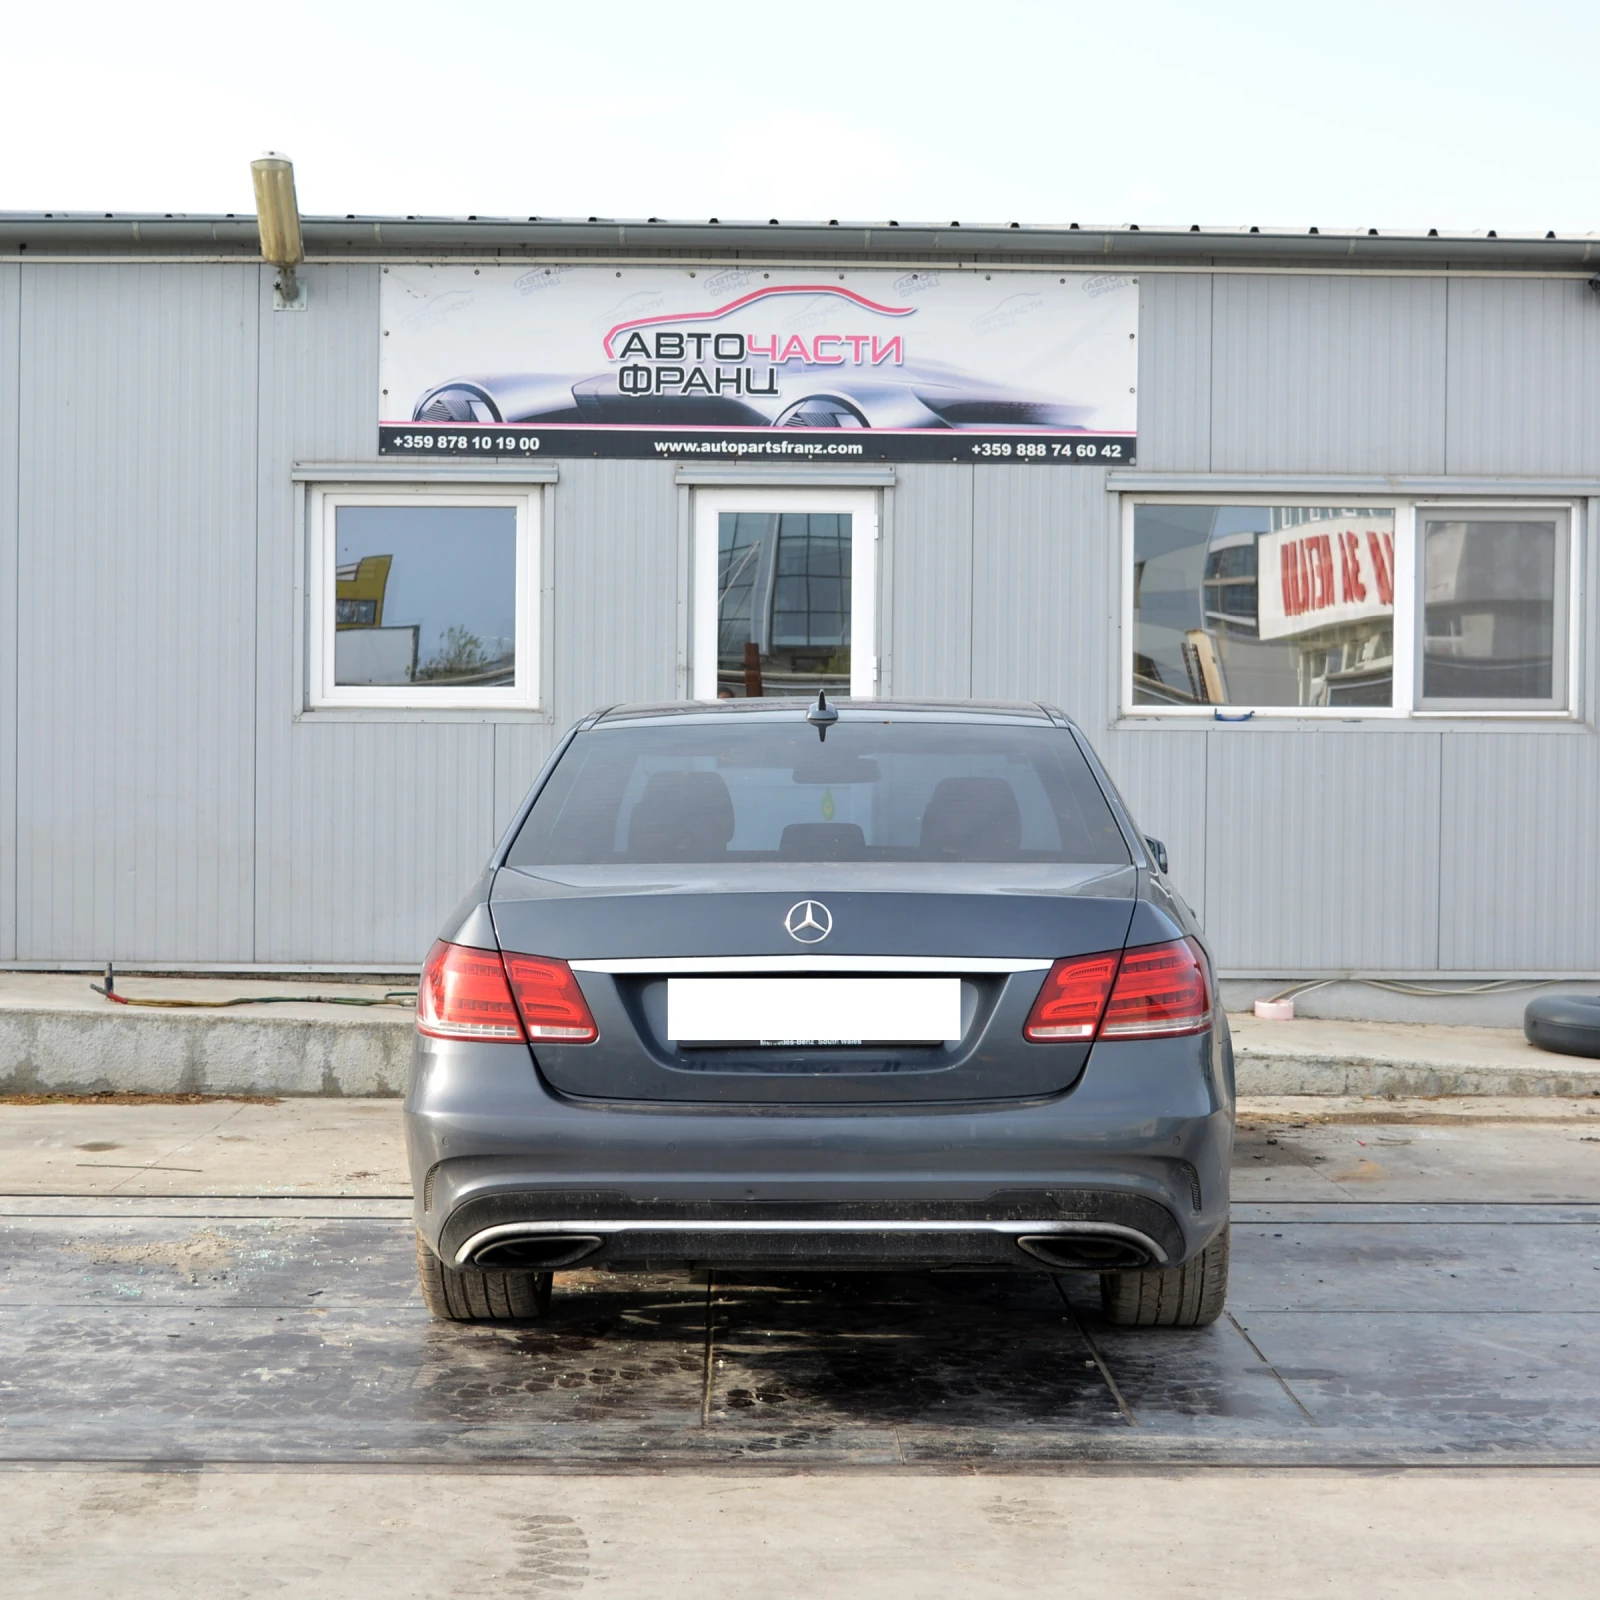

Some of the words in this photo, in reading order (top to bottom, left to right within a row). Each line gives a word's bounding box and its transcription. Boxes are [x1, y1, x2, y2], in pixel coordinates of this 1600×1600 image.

[619, 332, 903, 365] АВТОЧАСТИ
[619, 363, 779, 396] ФРАНЦ
[393, 435, 433, 449] +359
[438, 436, 467, 449] 878
[472, 436, 492, 450] 10
[496, 437, 516, 450] 19
[520, 437, 540, 450] 00
[654, 440, 863, 457] www.autopartsfranz.com
[971, 443, 1011, 457] +359
[1016, 444, 1046, 457] 888
[1052, 444, 1072, 457] 74
[1076, 444, 1097, 457] 60
[1101, 445, 1121, 458] 42
